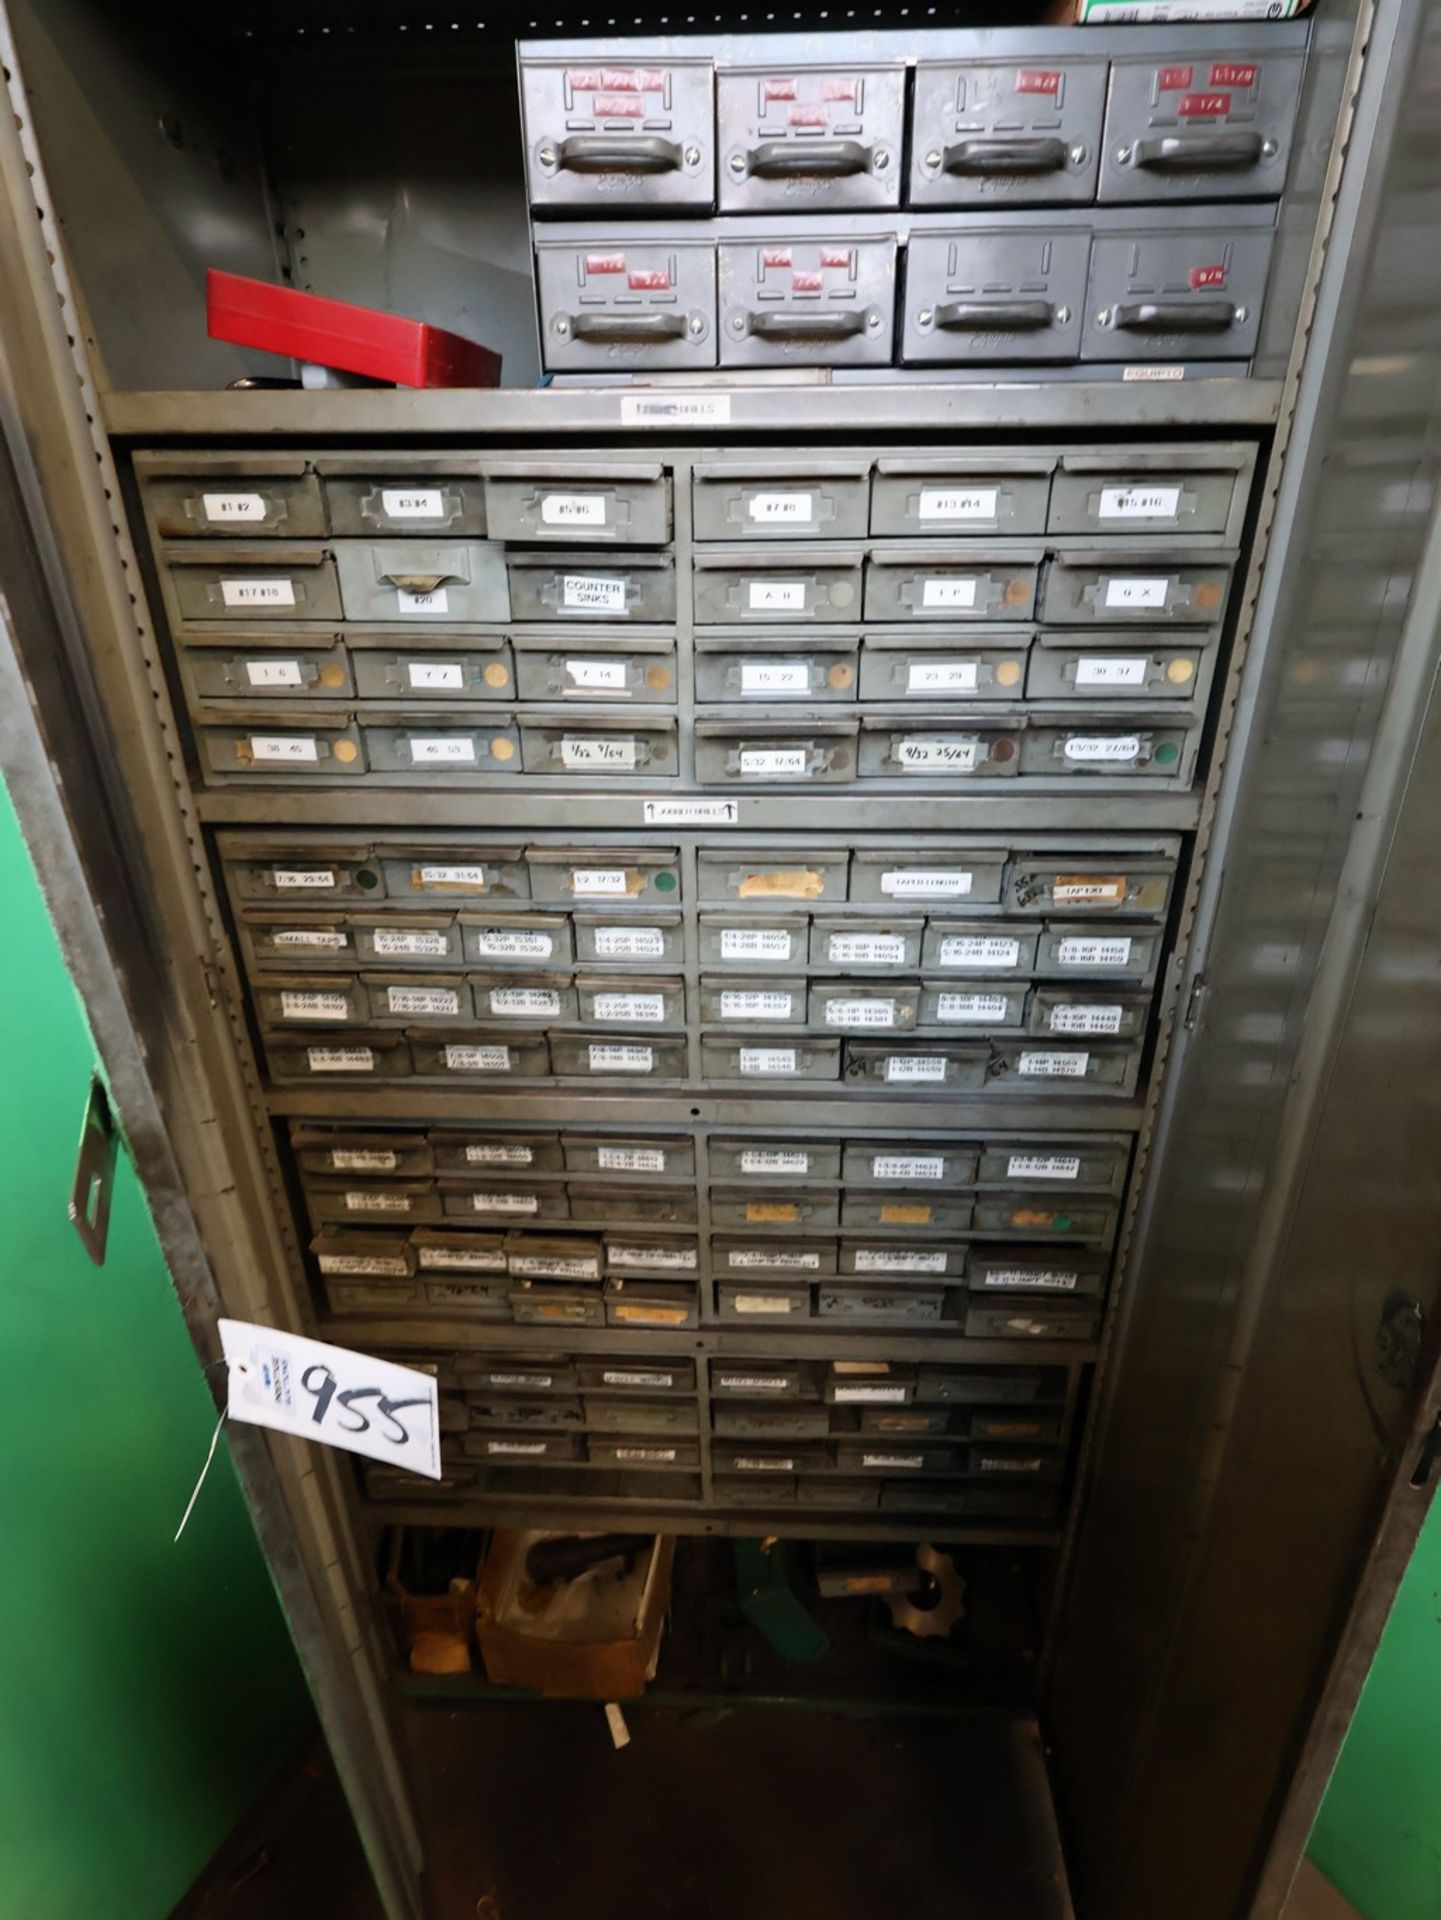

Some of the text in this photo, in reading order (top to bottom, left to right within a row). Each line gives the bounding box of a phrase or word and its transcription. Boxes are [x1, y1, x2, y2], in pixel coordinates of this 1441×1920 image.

[221, 503, 250, 512] #1 #2
[414, 499, 427, 508] #4
[566, 579, 621, 594] COUNTER
[576, 592, 610, 604] SINKS
[905, 746, 971, 760] 9/32 25/64
[301, 1365, 432, 1445] 955
